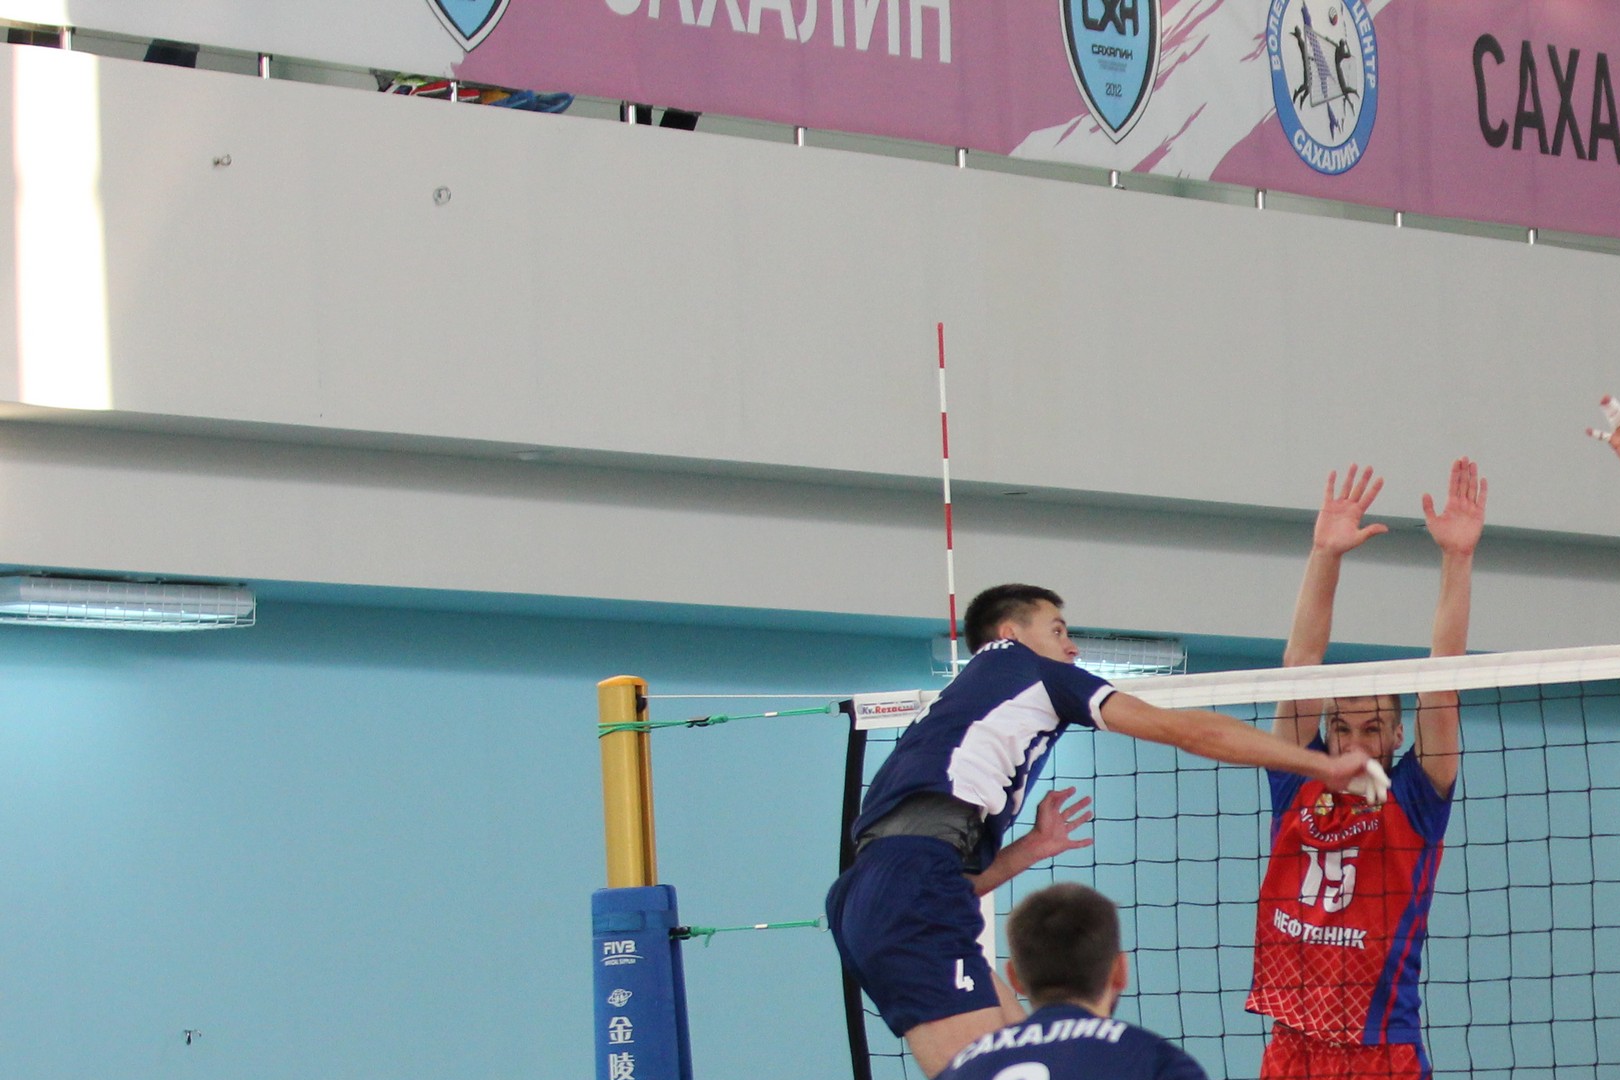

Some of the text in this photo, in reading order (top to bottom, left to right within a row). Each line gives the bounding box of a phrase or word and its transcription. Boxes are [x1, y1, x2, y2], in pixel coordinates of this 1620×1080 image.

[1105, 83, 1123, 97] 2012
[1293, 129, 1360, 172] САХАЛИН
[1299, 843, 1360, 913] 15
[603, 940, 636, 955] FIVB
[1273, 908, 1367, 949] НЕФТЯНИК
[955, 958, 975, 992] 4
[953, 1018, 1128, 1070] САХАЛИН
